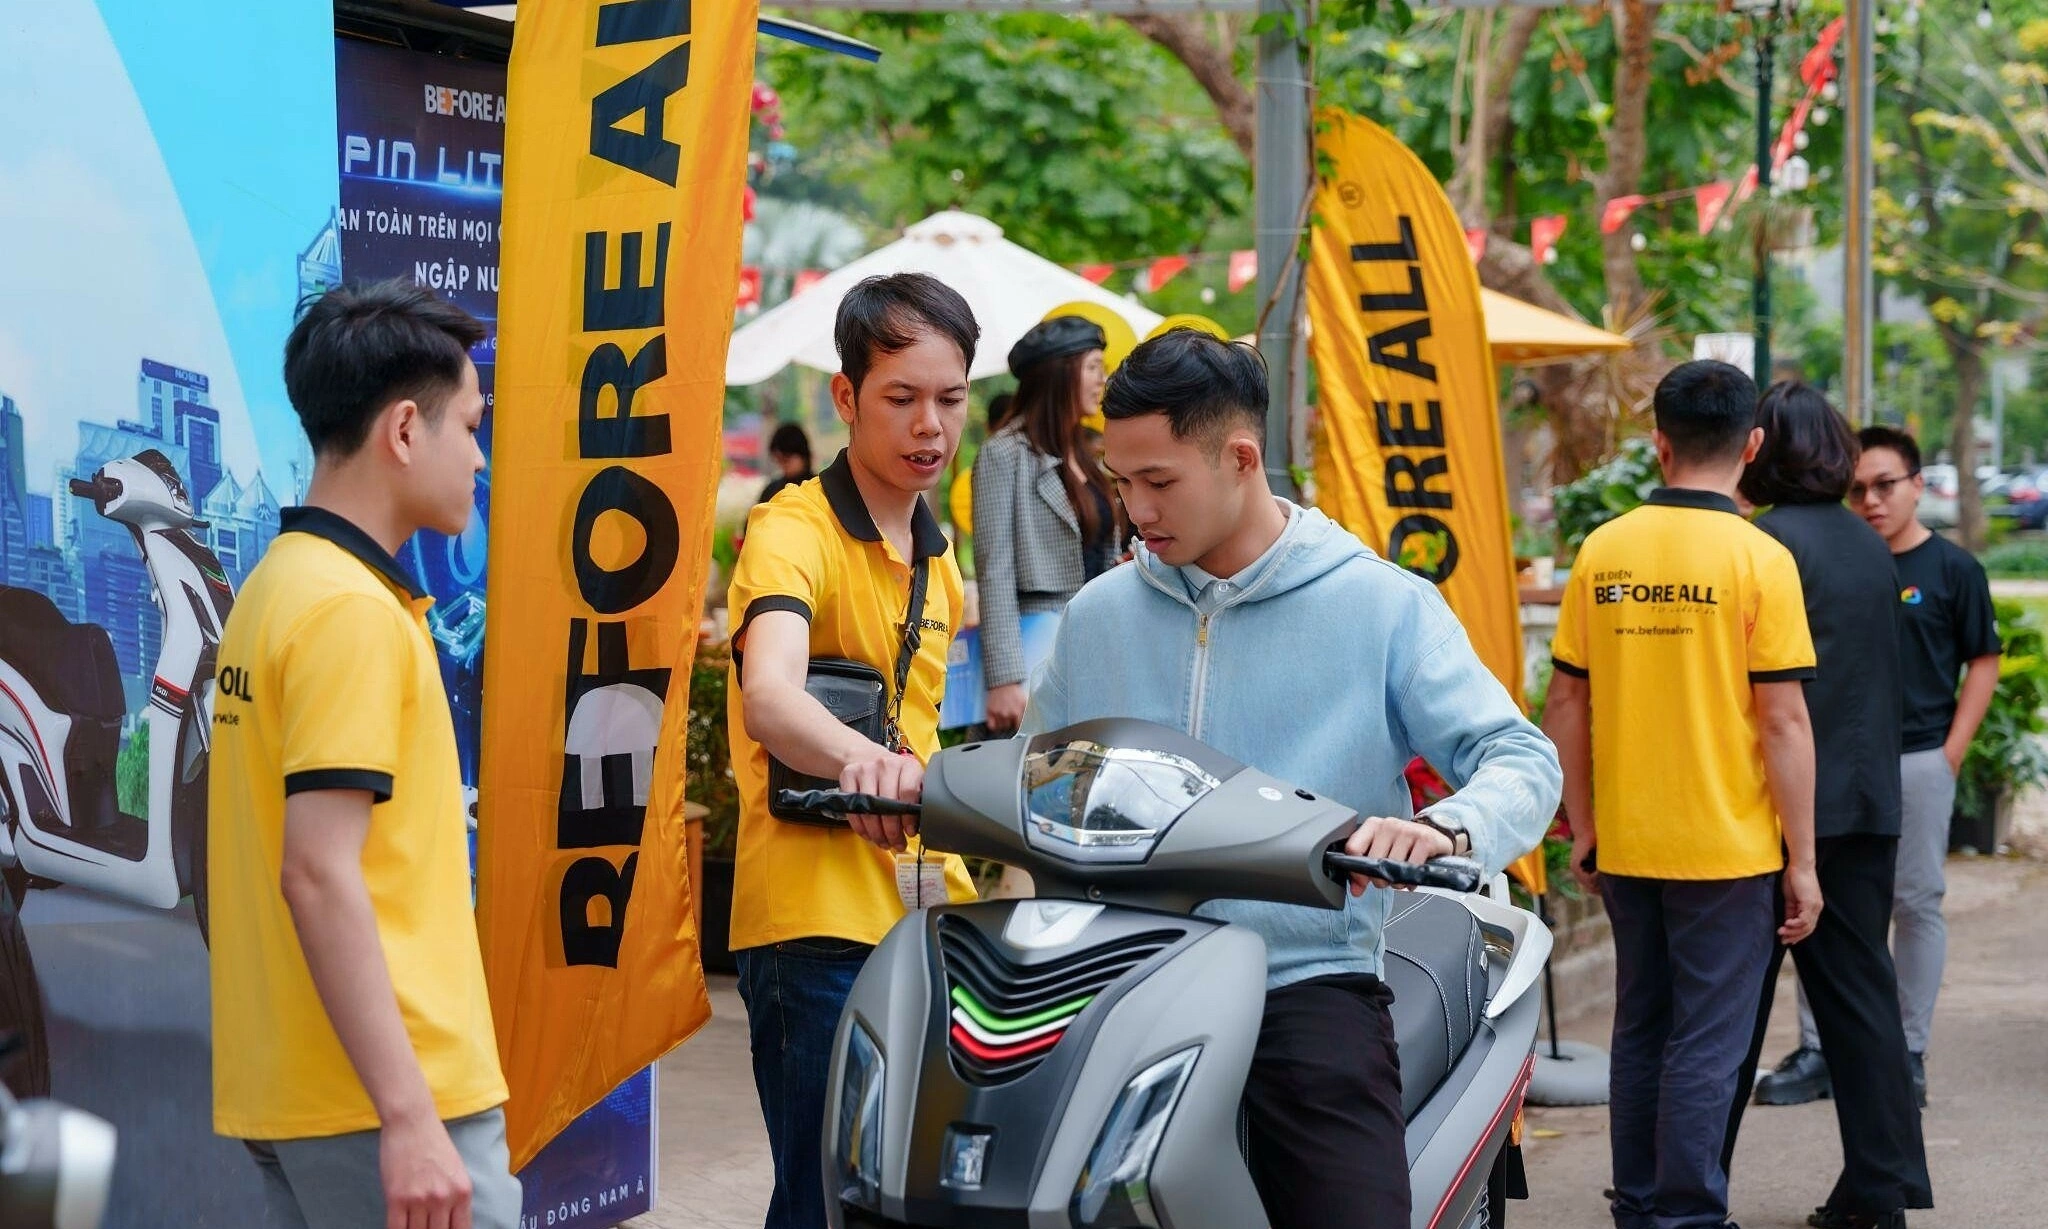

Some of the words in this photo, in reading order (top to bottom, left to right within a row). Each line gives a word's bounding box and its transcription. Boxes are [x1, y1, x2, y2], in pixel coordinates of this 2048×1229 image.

[424, 84, 494, 121] BEFORE
[366, 207, 412, 236] TOÀN
[418, 213, 457, 240] TRÊN
[462, 219, 492, 249] MỌI
[414, 257, 470, 298] NGẬP
[1350, 215, 1438, 384] ALL
[557, 221, 680, 968] BEFORE
[1594, 584, 1675, 605] BEFORE
[1678, 584, 1718, 605] ALL
[599, 1183, 629, 1208] NAM
